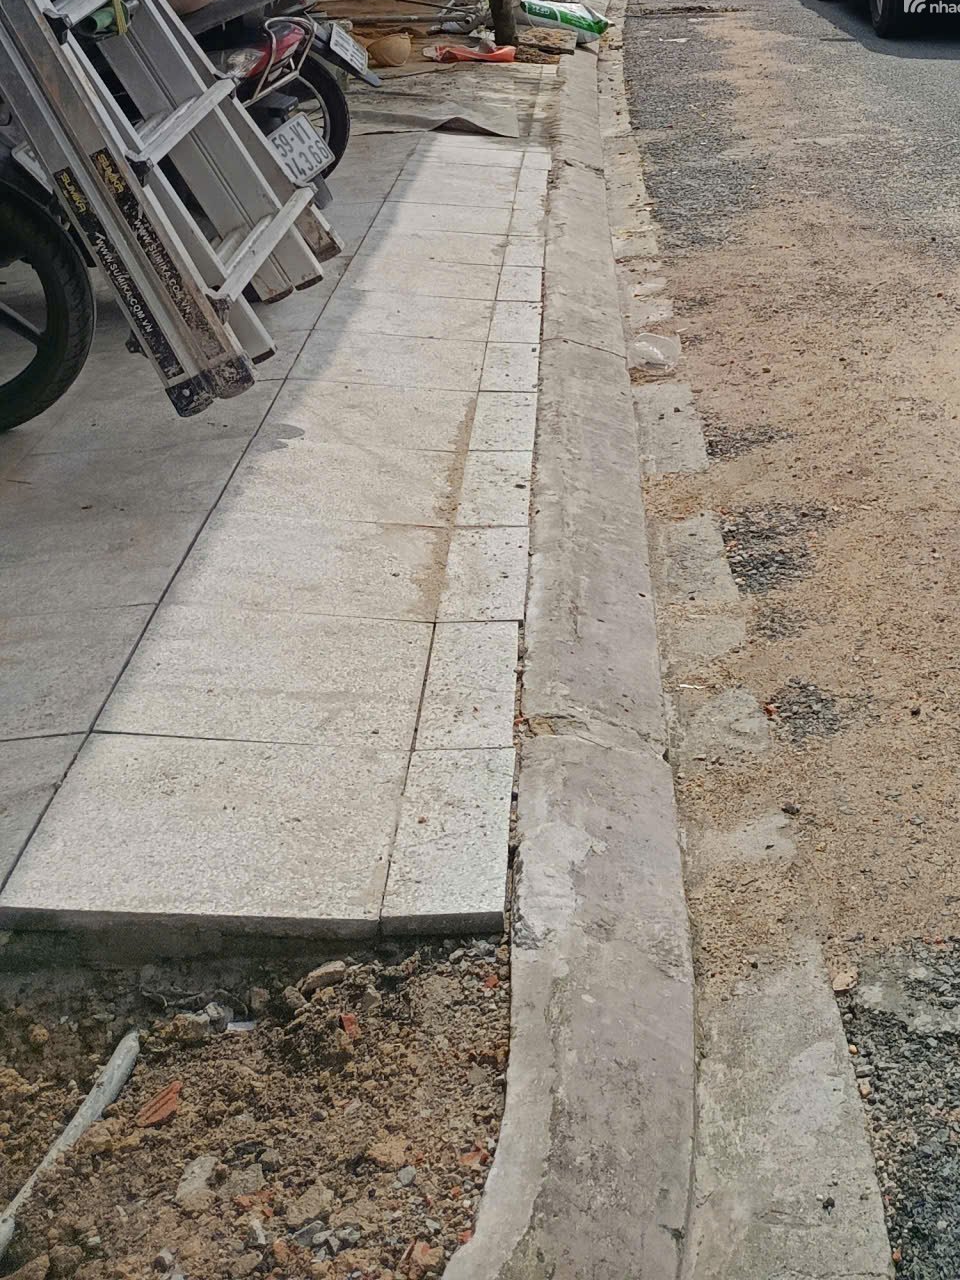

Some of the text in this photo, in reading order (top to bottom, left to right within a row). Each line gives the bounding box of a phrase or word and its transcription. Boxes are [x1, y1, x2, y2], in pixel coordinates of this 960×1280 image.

[285, 140, 329, 179] 143.66
[60, 172, 87, 213] SUMIKA
[95, 238, 153, 333] WWW.SUMIKA.COM.VN
